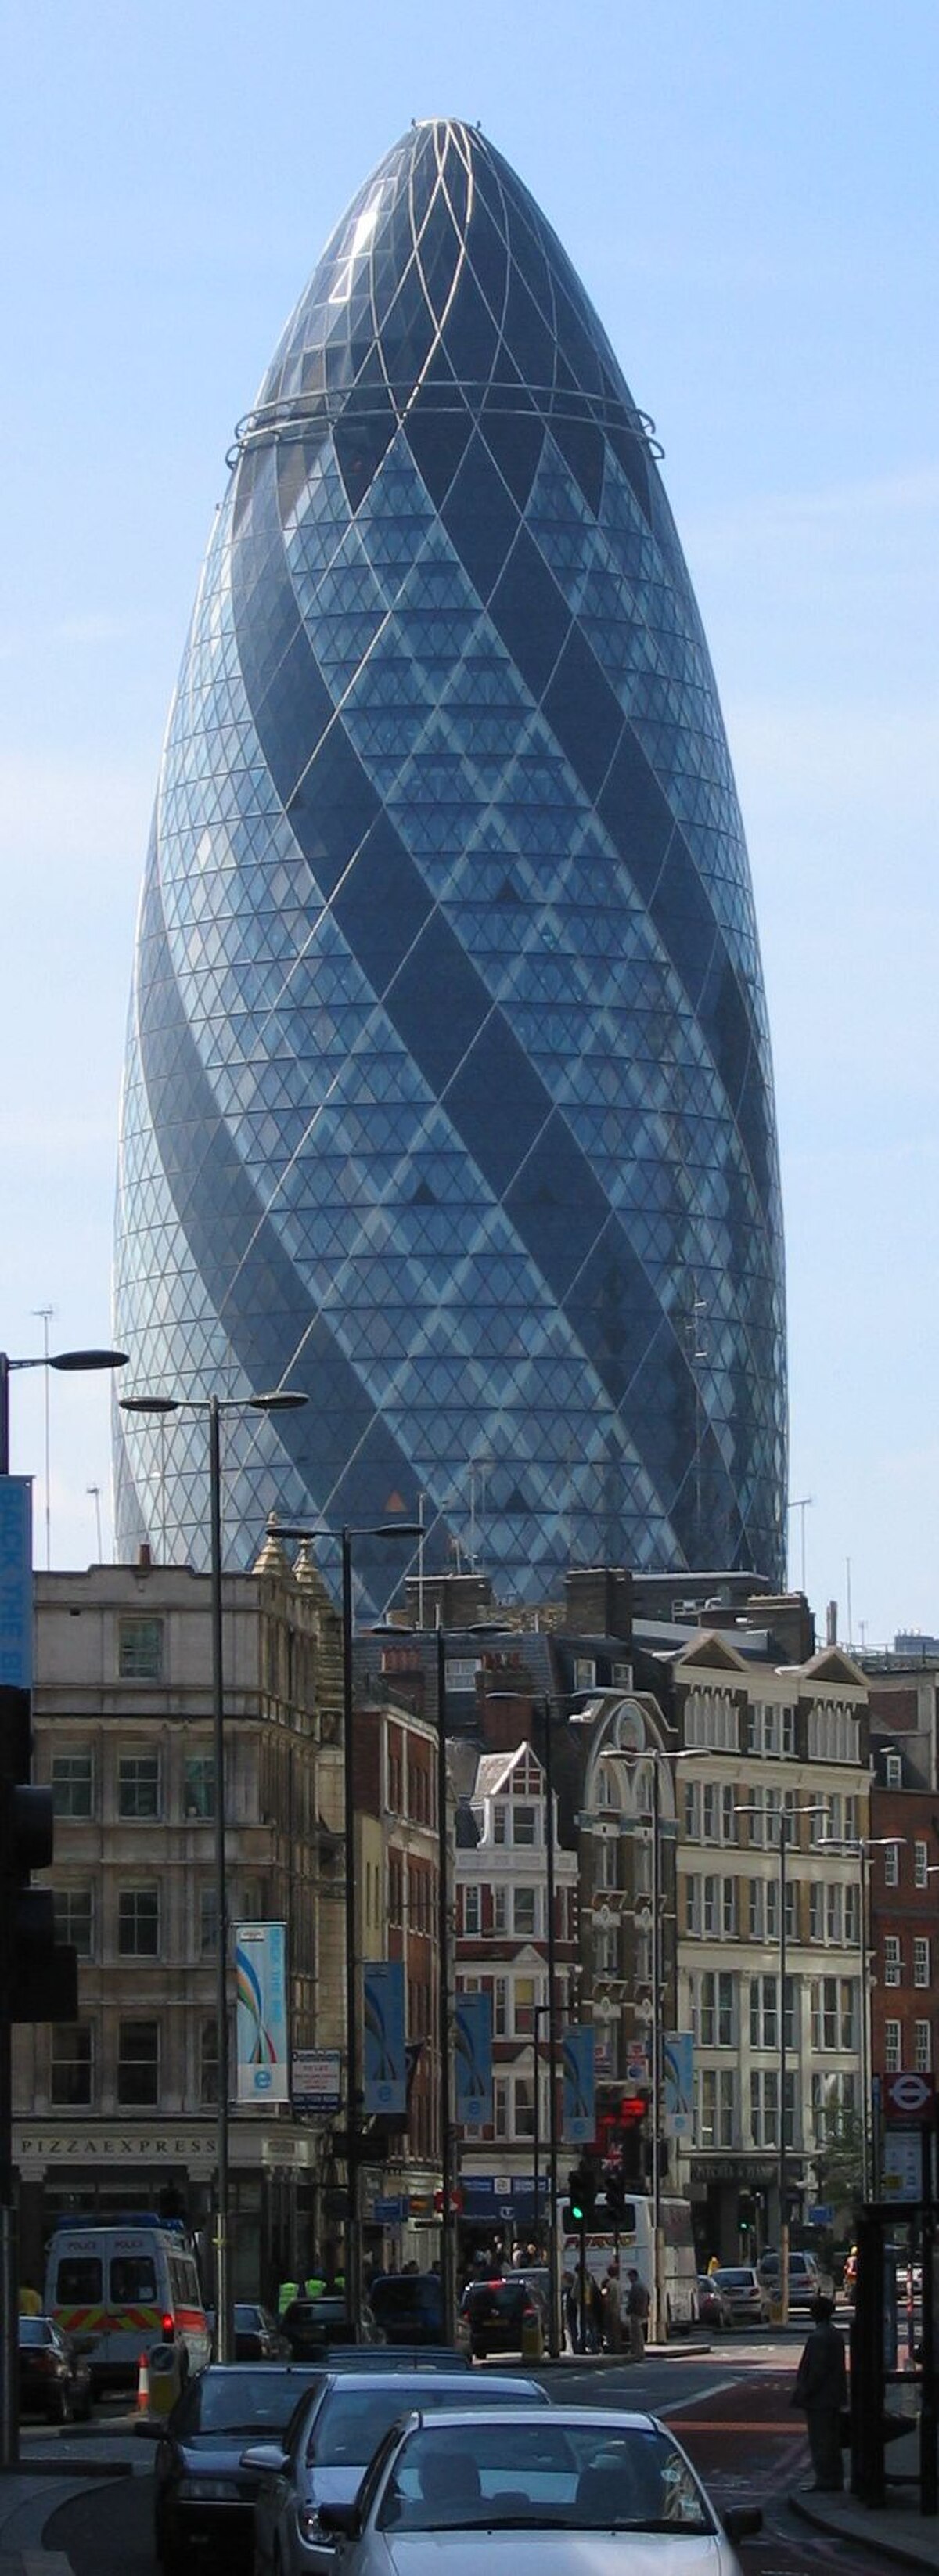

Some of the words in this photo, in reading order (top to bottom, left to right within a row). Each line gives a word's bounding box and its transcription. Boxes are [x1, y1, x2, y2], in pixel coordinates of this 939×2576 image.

[2, 1489, 23, 1567] BACK
[2, 1583, 23, 1641] THE
[21, 2139, 218, 2153] PIZZAEXPRESS
